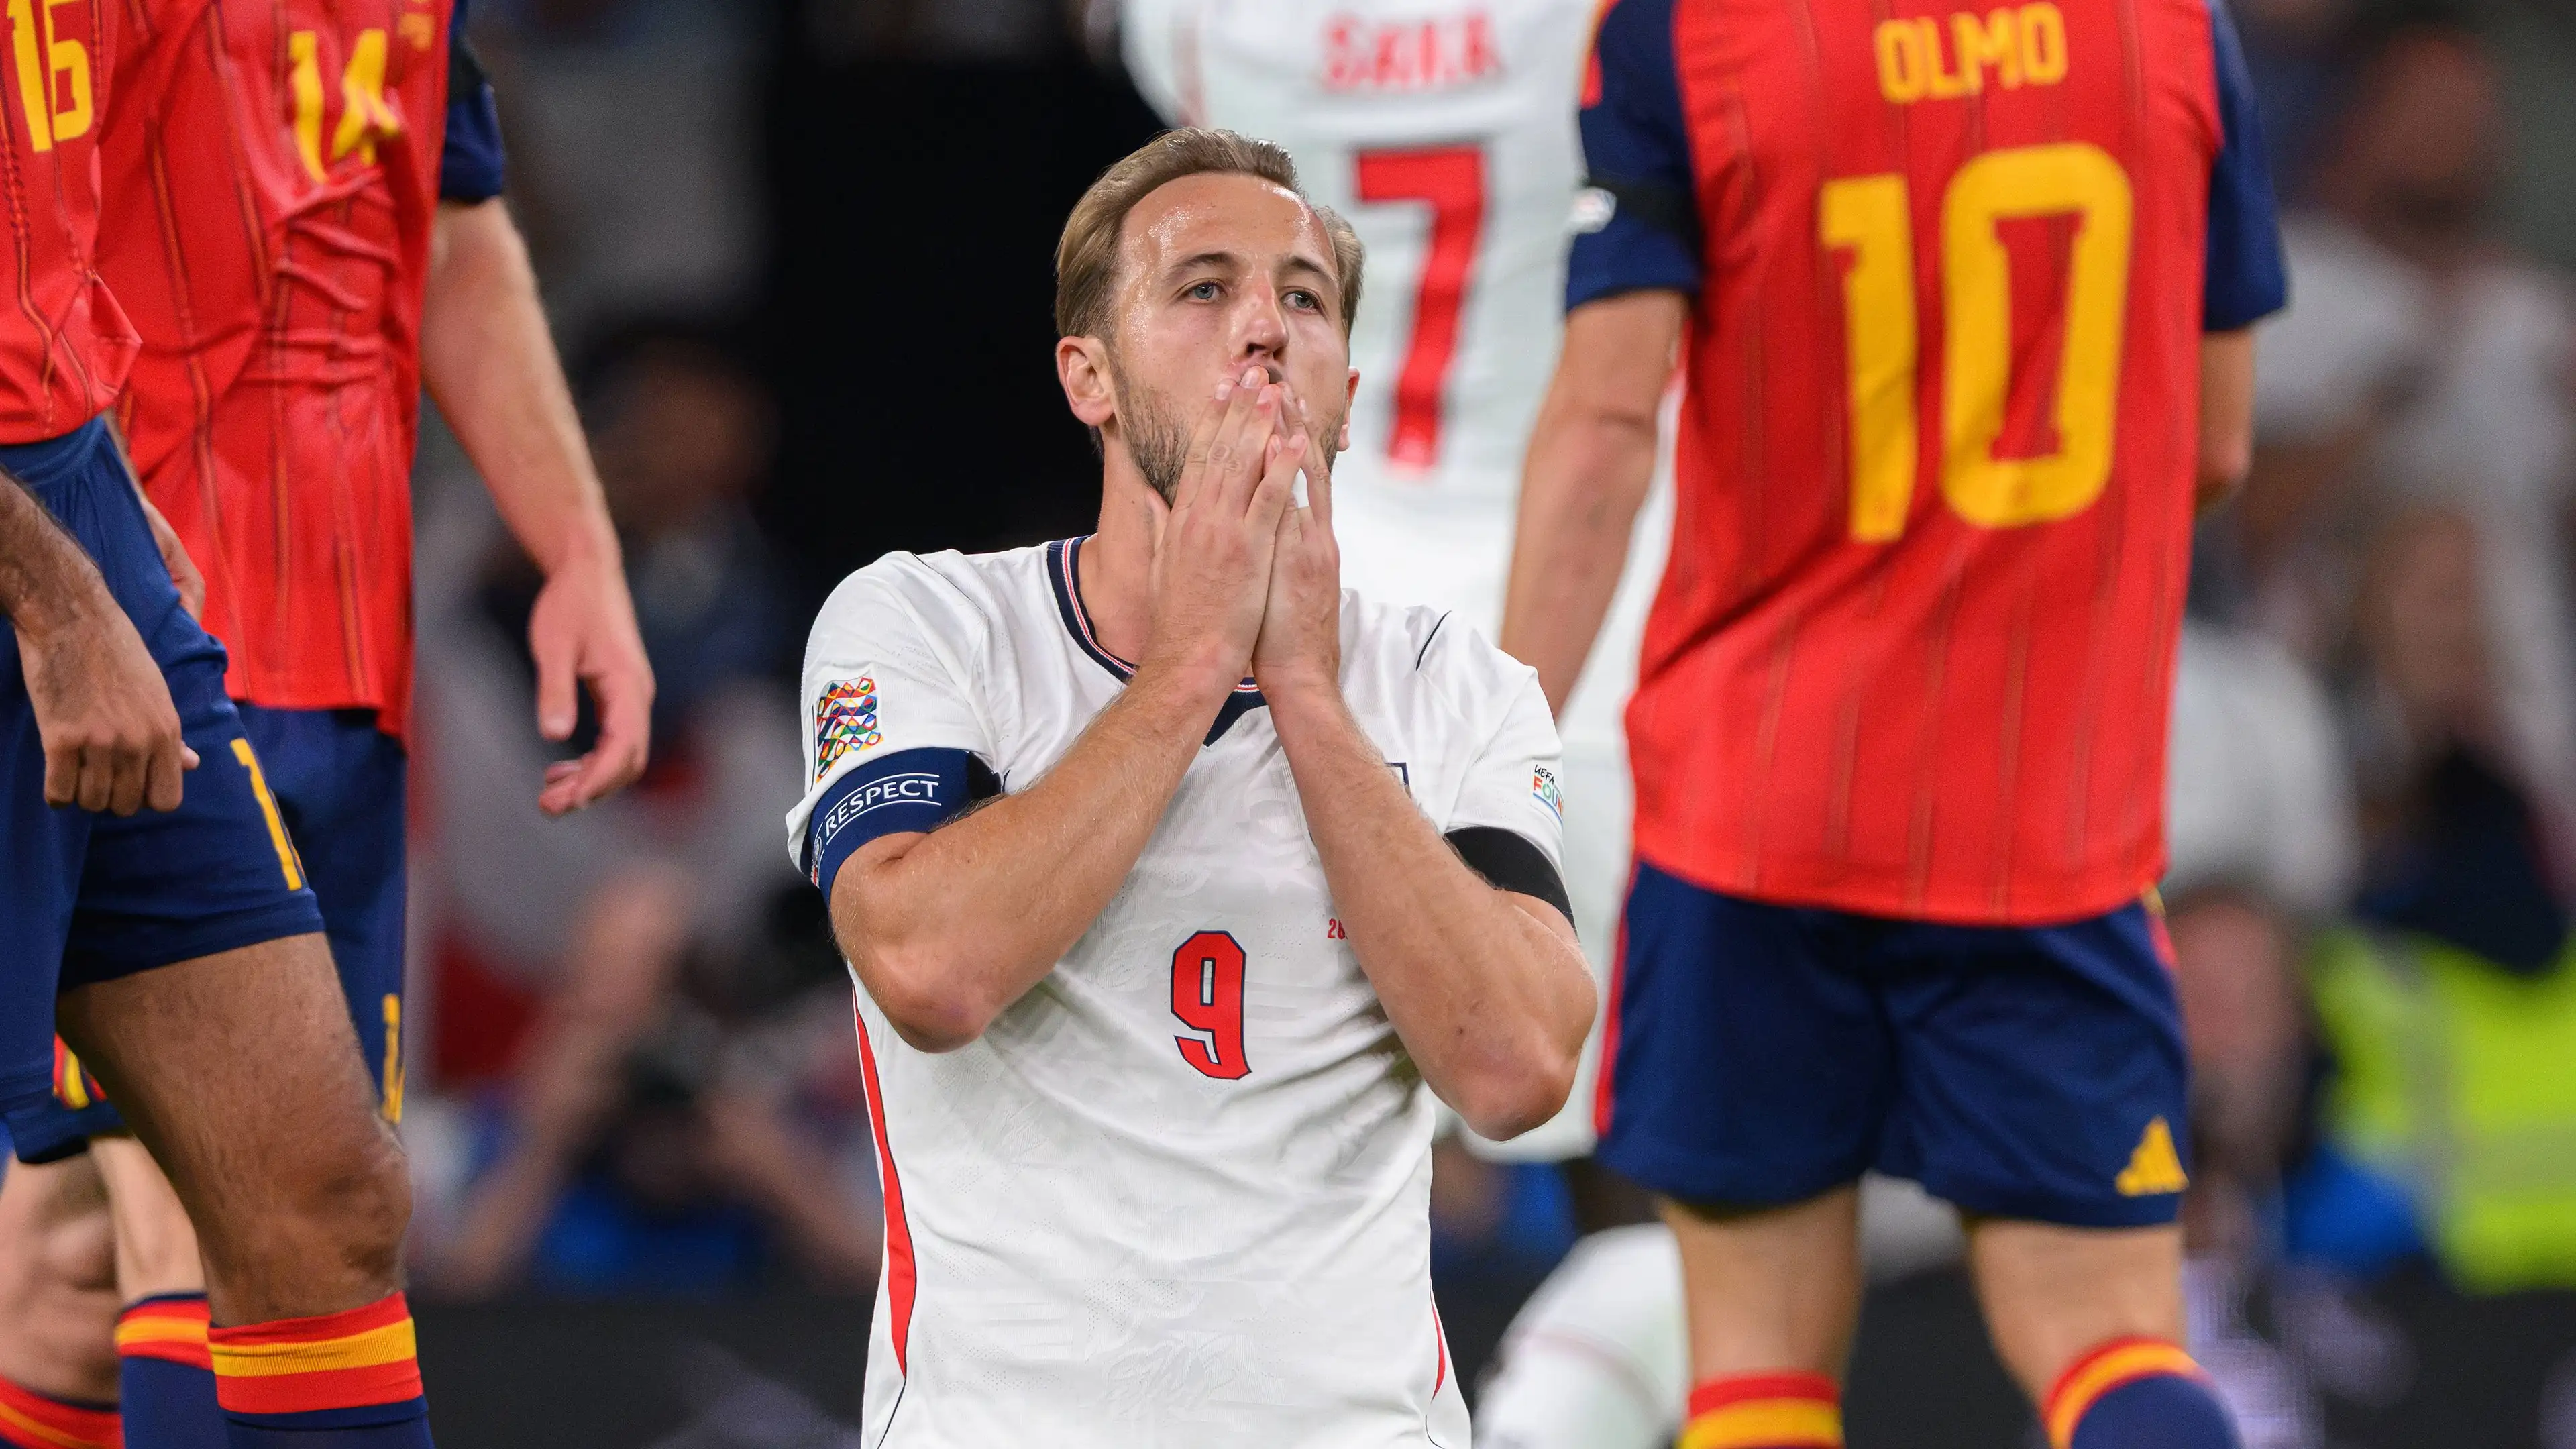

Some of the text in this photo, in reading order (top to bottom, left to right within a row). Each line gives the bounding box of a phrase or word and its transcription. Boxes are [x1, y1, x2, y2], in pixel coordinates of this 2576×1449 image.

[8, 0, 93, 152] 16
[288, 29, 401, 183] 14
[1877, 3, 2068, 104] OLMO
[1356, 146, 1487, 473] 7
[1820, 142, 2133, 542] 10
[825, 780, 938, 837] RESPECT
[1534, 764, 1555, 785] UEFA
[1171, 930, 1252, 1081] 9
